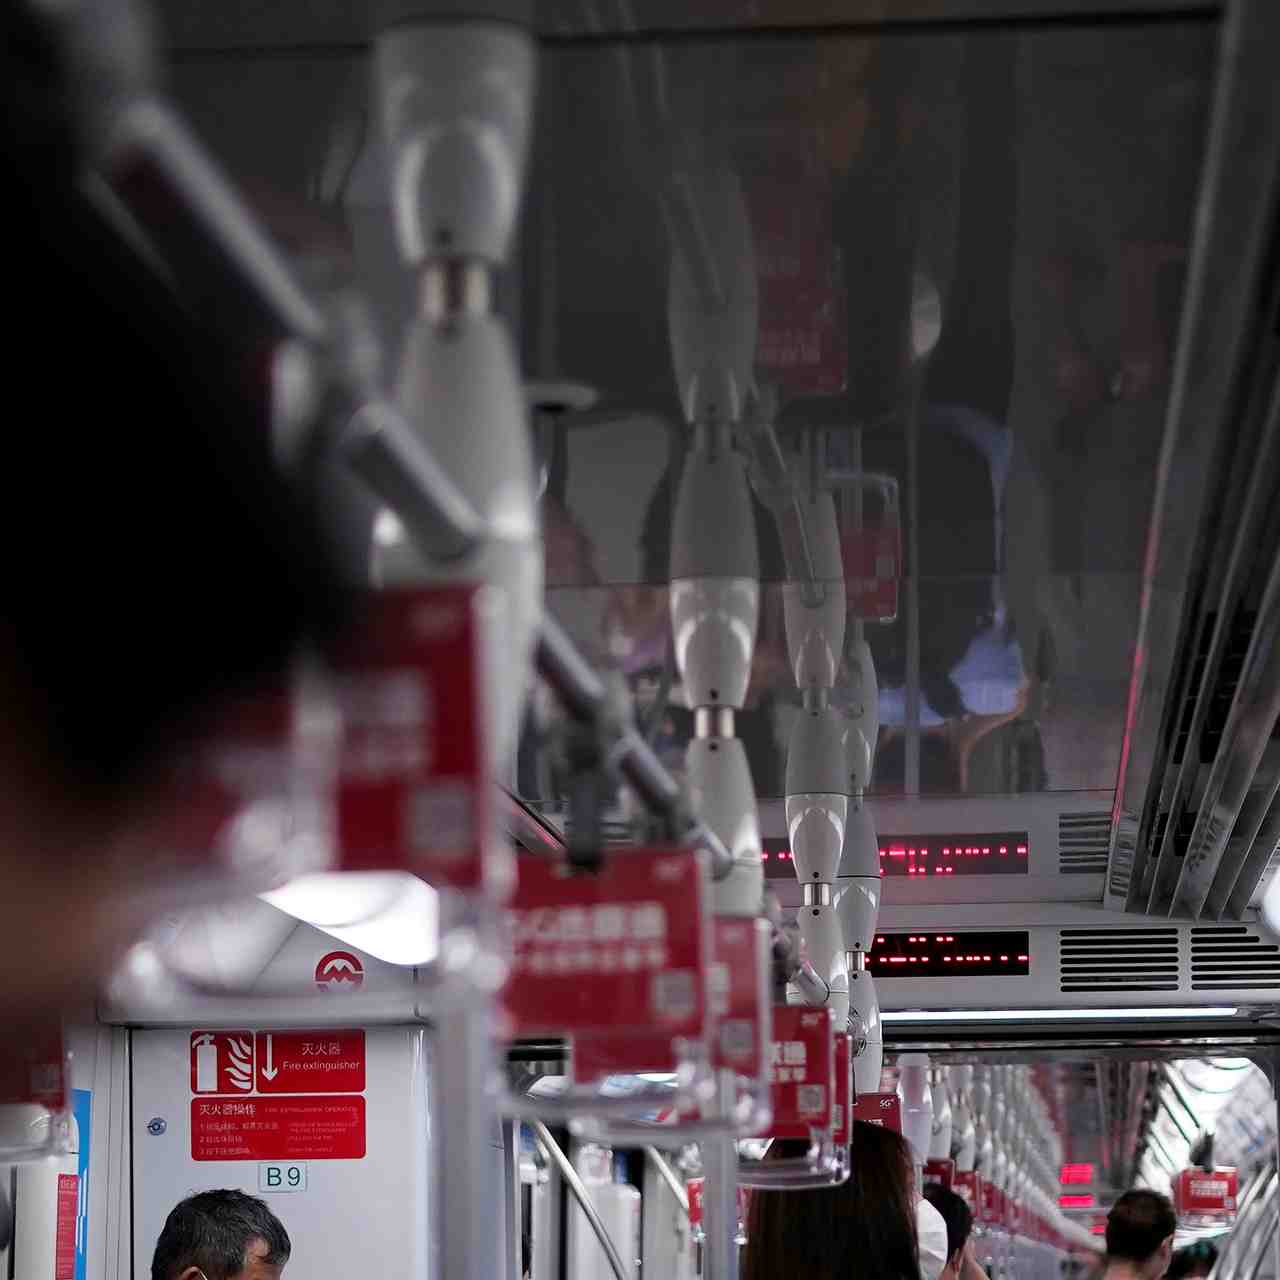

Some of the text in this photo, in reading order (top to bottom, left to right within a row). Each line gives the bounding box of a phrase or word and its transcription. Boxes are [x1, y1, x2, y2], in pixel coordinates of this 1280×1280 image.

[301, 1042, 342, 1056] 灭火器
[283, 1060, 361, 1072] Fire extinguisher
